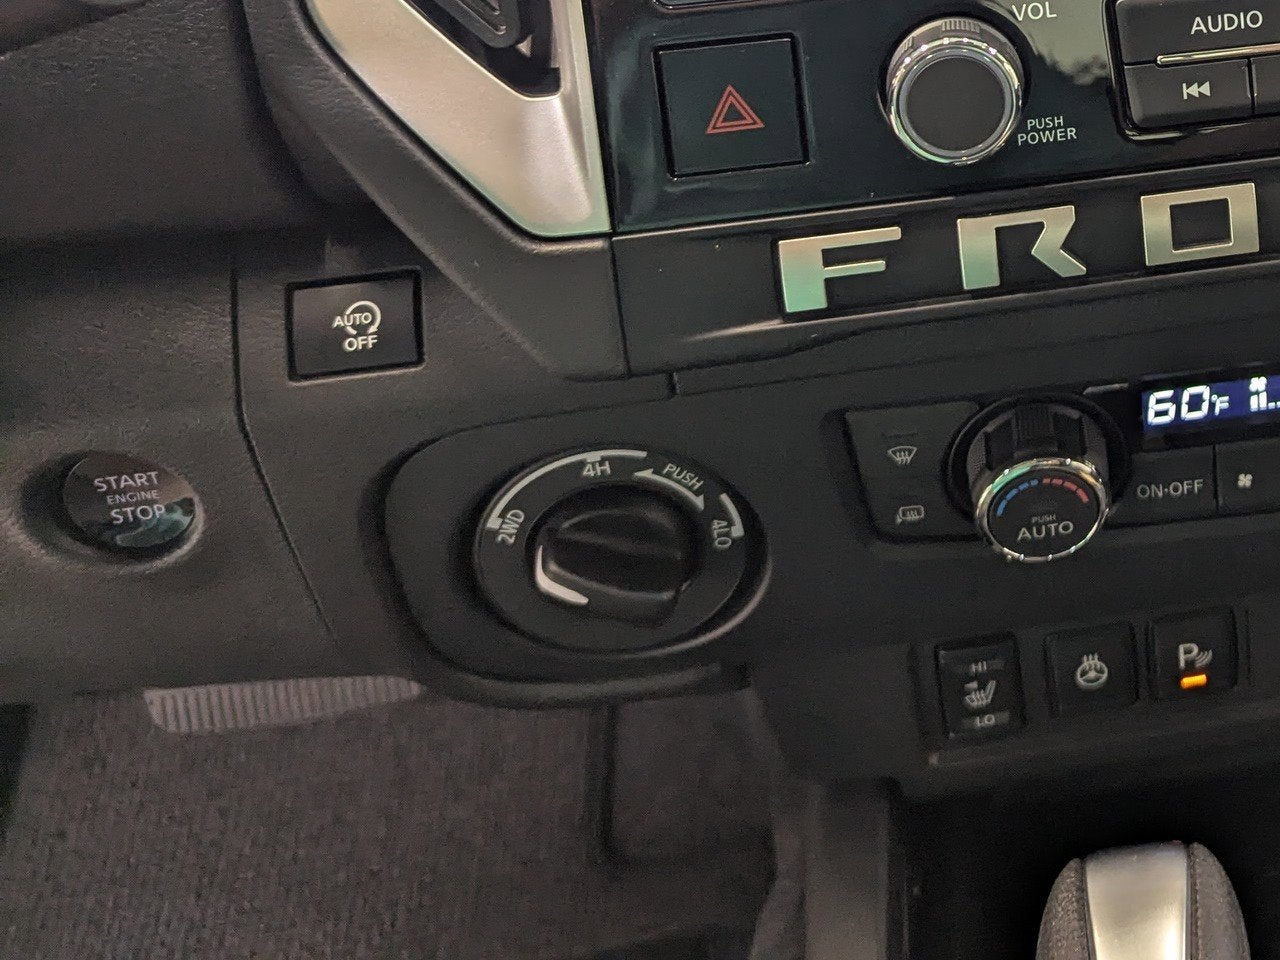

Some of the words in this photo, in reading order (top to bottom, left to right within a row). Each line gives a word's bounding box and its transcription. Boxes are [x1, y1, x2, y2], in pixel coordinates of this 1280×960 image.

[1011, 1, 1057, 22] VOL
[1190, 9, 1263, 36] AUDIO
[1027, 115, 1064, 130] PUSH
[1017, 127, 1077, 146] POWER
[331, 311, 372, 329] AUTO
[342, 334, 379, 352] OFF
[582, 461, 611, 478] 4H
[662, 463, 702, 490] PUSH
[93, 471, 160, 493] START
[106, 489, 160, 505] ENGINE
[110, 502, 166, 525] STOP
[495, 509, 525, 544] 2WD
[711, 518, 732, 549] 4LO
[1016, 519, 1074, 542] AUTO
[976, 713, 996, 727] LO
